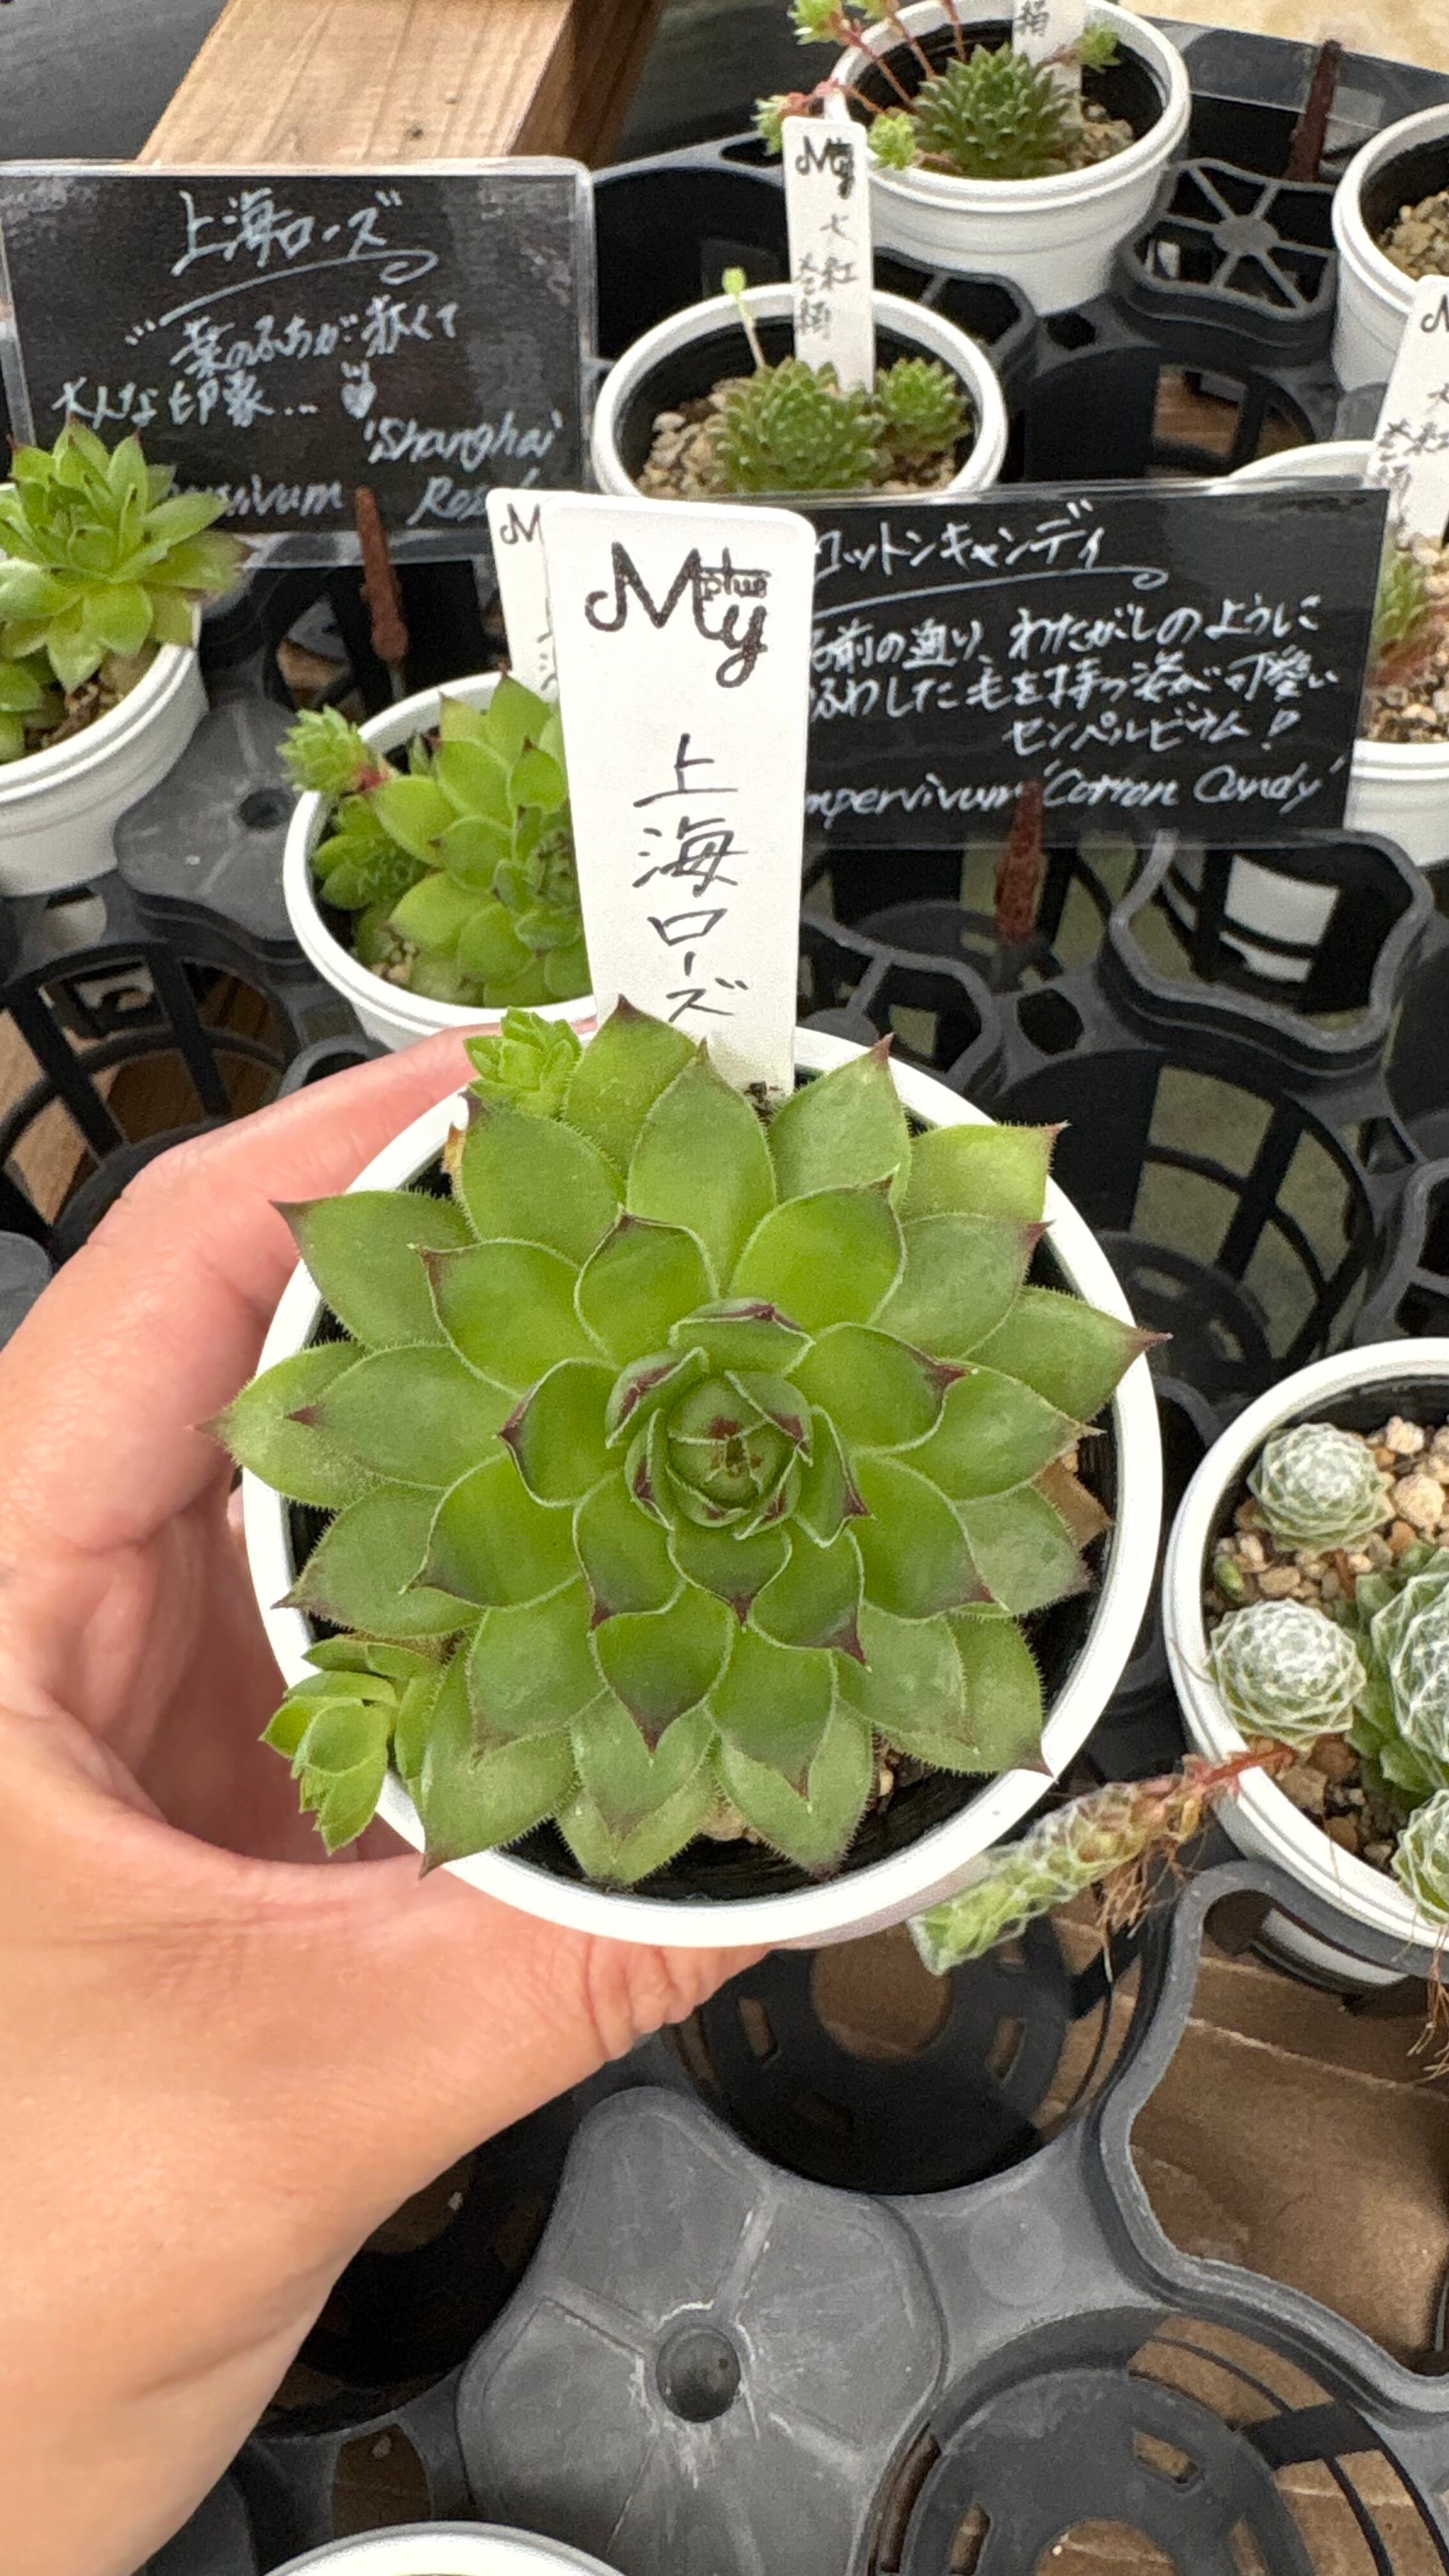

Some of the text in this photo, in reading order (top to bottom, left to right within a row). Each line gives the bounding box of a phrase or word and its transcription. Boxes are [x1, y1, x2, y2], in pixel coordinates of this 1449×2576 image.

[171, 187, 402, 277] 上海ローズ
[499, 502, 544, 544] M
[632, 733, 749, 1022] 上海ローズ
